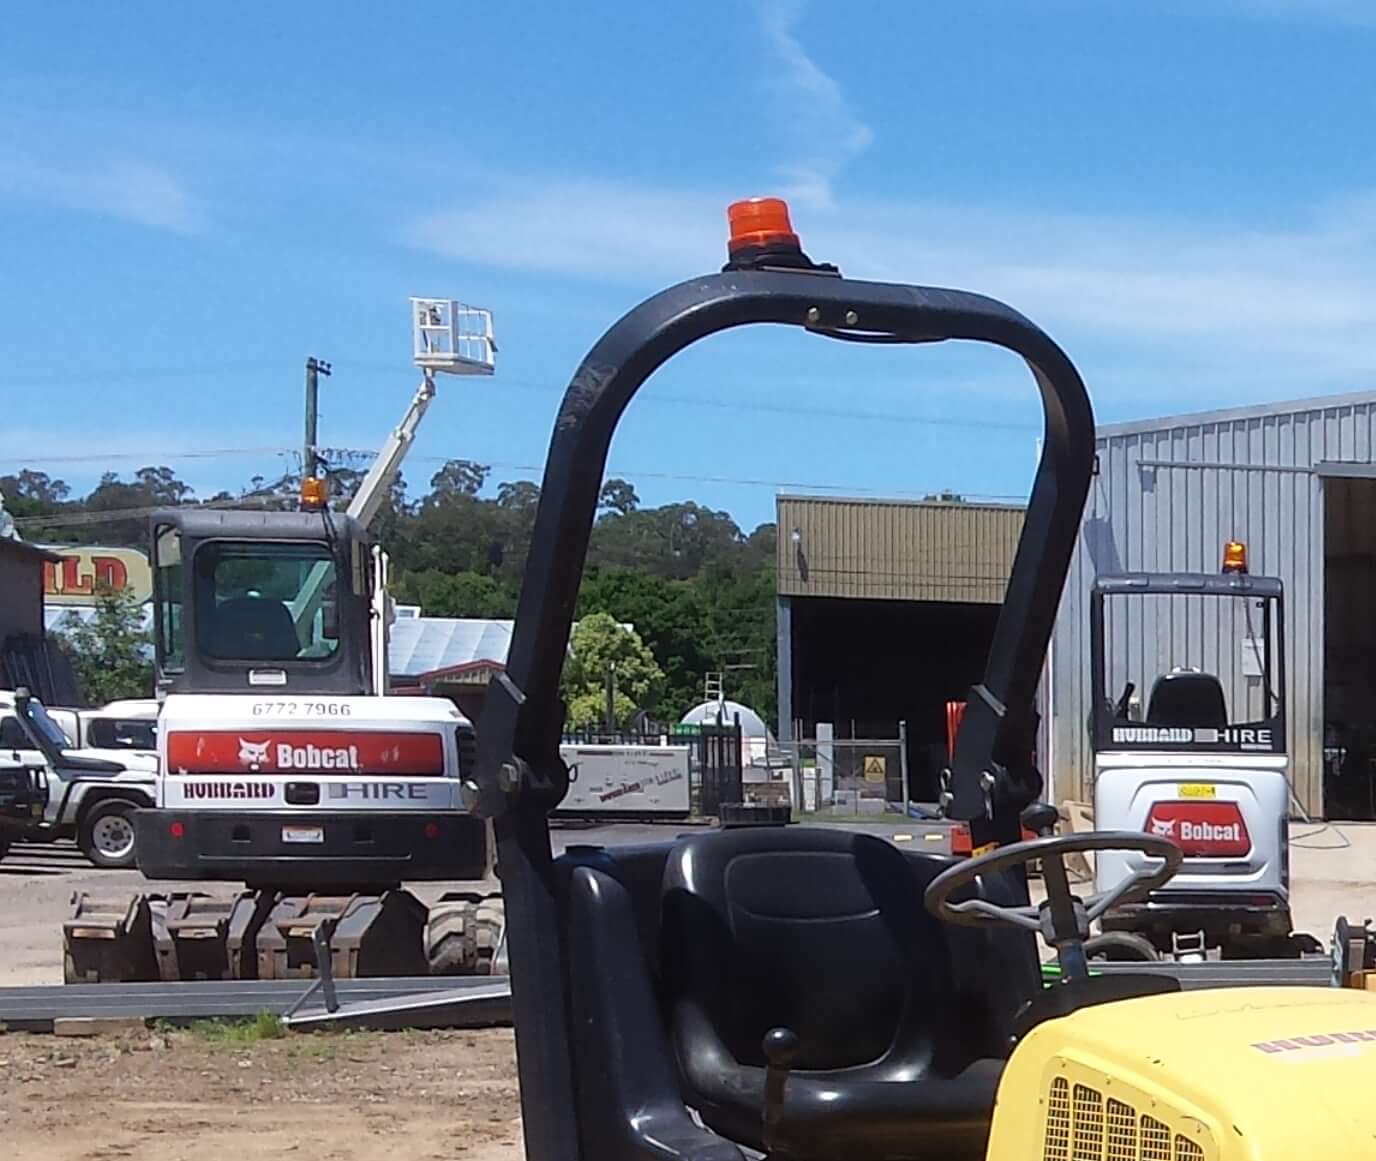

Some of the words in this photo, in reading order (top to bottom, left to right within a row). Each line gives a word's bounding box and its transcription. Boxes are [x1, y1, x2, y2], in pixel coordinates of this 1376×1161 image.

[1210, 728, 1273, 743] HIRE
[276, 743, 359, 769] Bobcat
[183, 782, 276, 799] HUBBARD
[338, 782, 428, 800] HIRE
[1180, 821, 1241, 841] Bobcat
